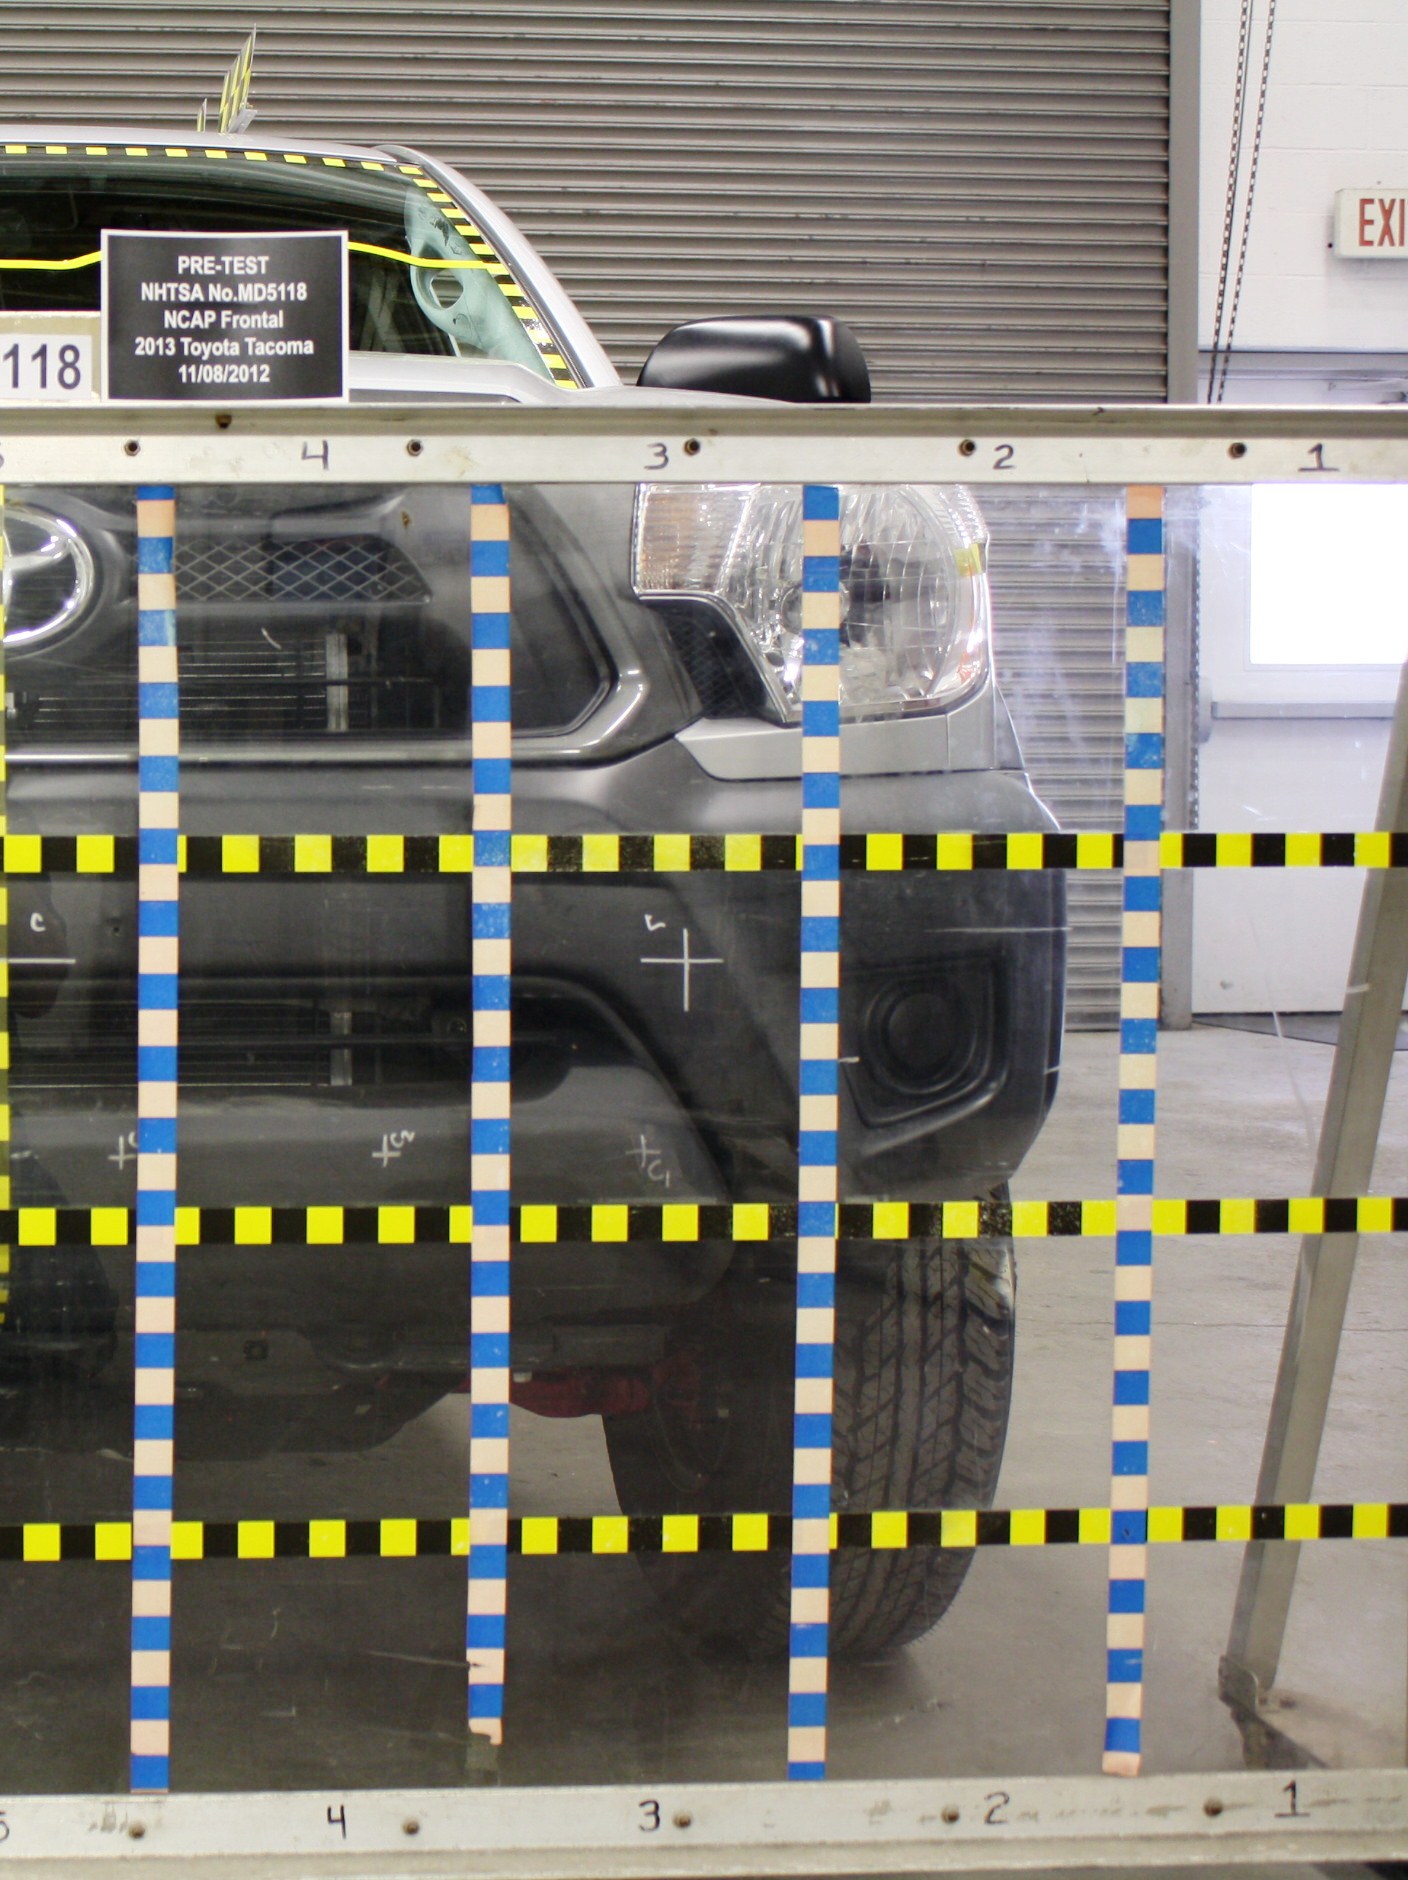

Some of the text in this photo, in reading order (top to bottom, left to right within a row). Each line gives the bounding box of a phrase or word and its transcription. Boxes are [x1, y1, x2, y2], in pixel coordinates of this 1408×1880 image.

[1358, 198, 1408, 247] EXI
[178, 255, 270, 275] PRE-TEST
[141, 282, 307, 302] NHTSA No.MD5118
[163, 310, 284, 329] NCAP Frontal
[134, 336, 314, 361] 2013 Toyota Tacoma
[178, 364, 271, 384] 11/08/2012
[301, 439, 330, 470] 4
[643, 442, 670, 471] 3
[992, 444, 1016, 471] 2
[1297, 443, 1340, 472] 1
[29, 911, 47, 932] C
[325, 1804, 347, 1839] 4
[638, 1799, 661, 1832] 3
[983, 1791, 1011, 1825] 2
[1274, 1780, 1310, 1818] 1
